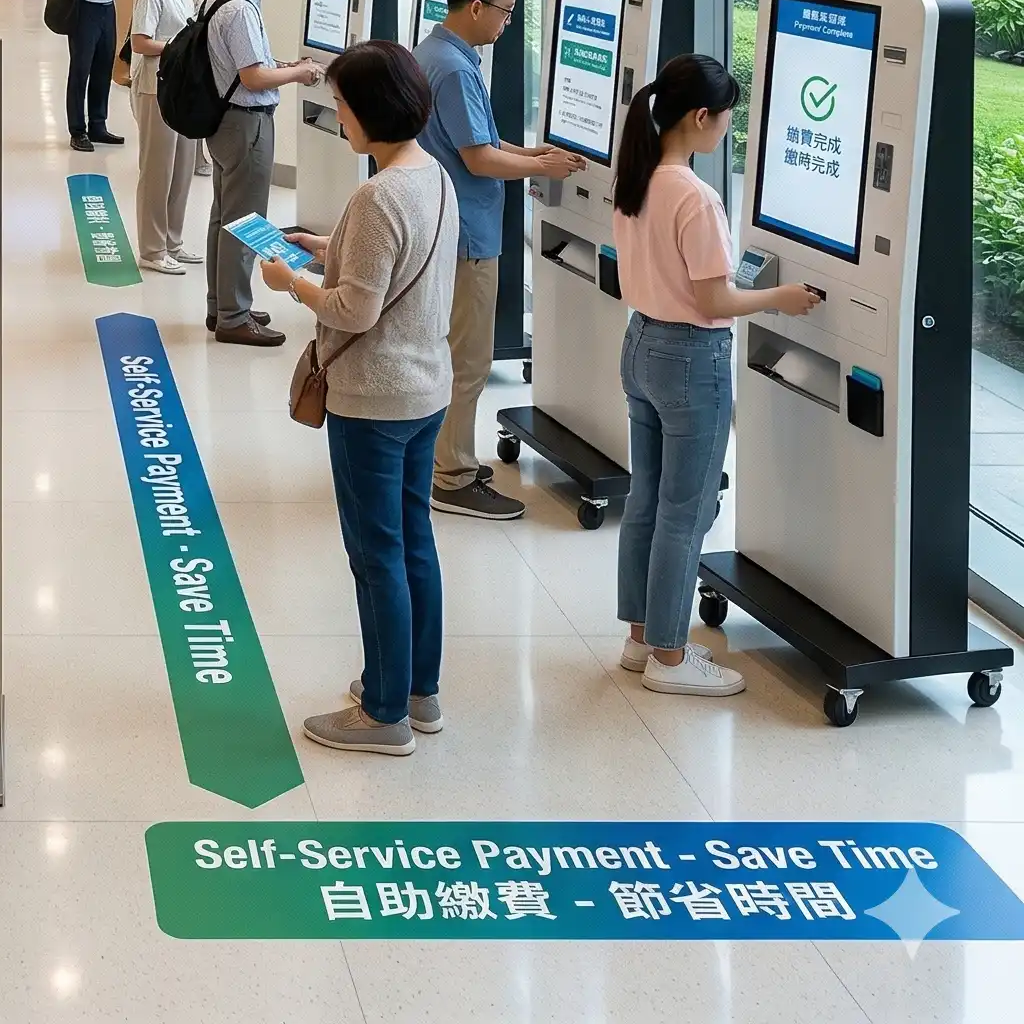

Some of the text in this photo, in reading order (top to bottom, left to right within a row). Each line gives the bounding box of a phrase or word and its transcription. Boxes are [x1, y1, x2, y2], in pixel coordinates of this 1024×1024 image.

[140, 453, 202, 537] Payment
[169, 558, 214, 613] Save
[183, 619, 235, 684] Time
[193, 838, 462, 870] Self-Service
[471, 839, 671, 876] Payment
[712, 839, 817, 870] Save
[817, 839, 939, 870] Time
[320, 880, 558, 921] 自助繳費
[608, 880, 857, 921] 節省時間
